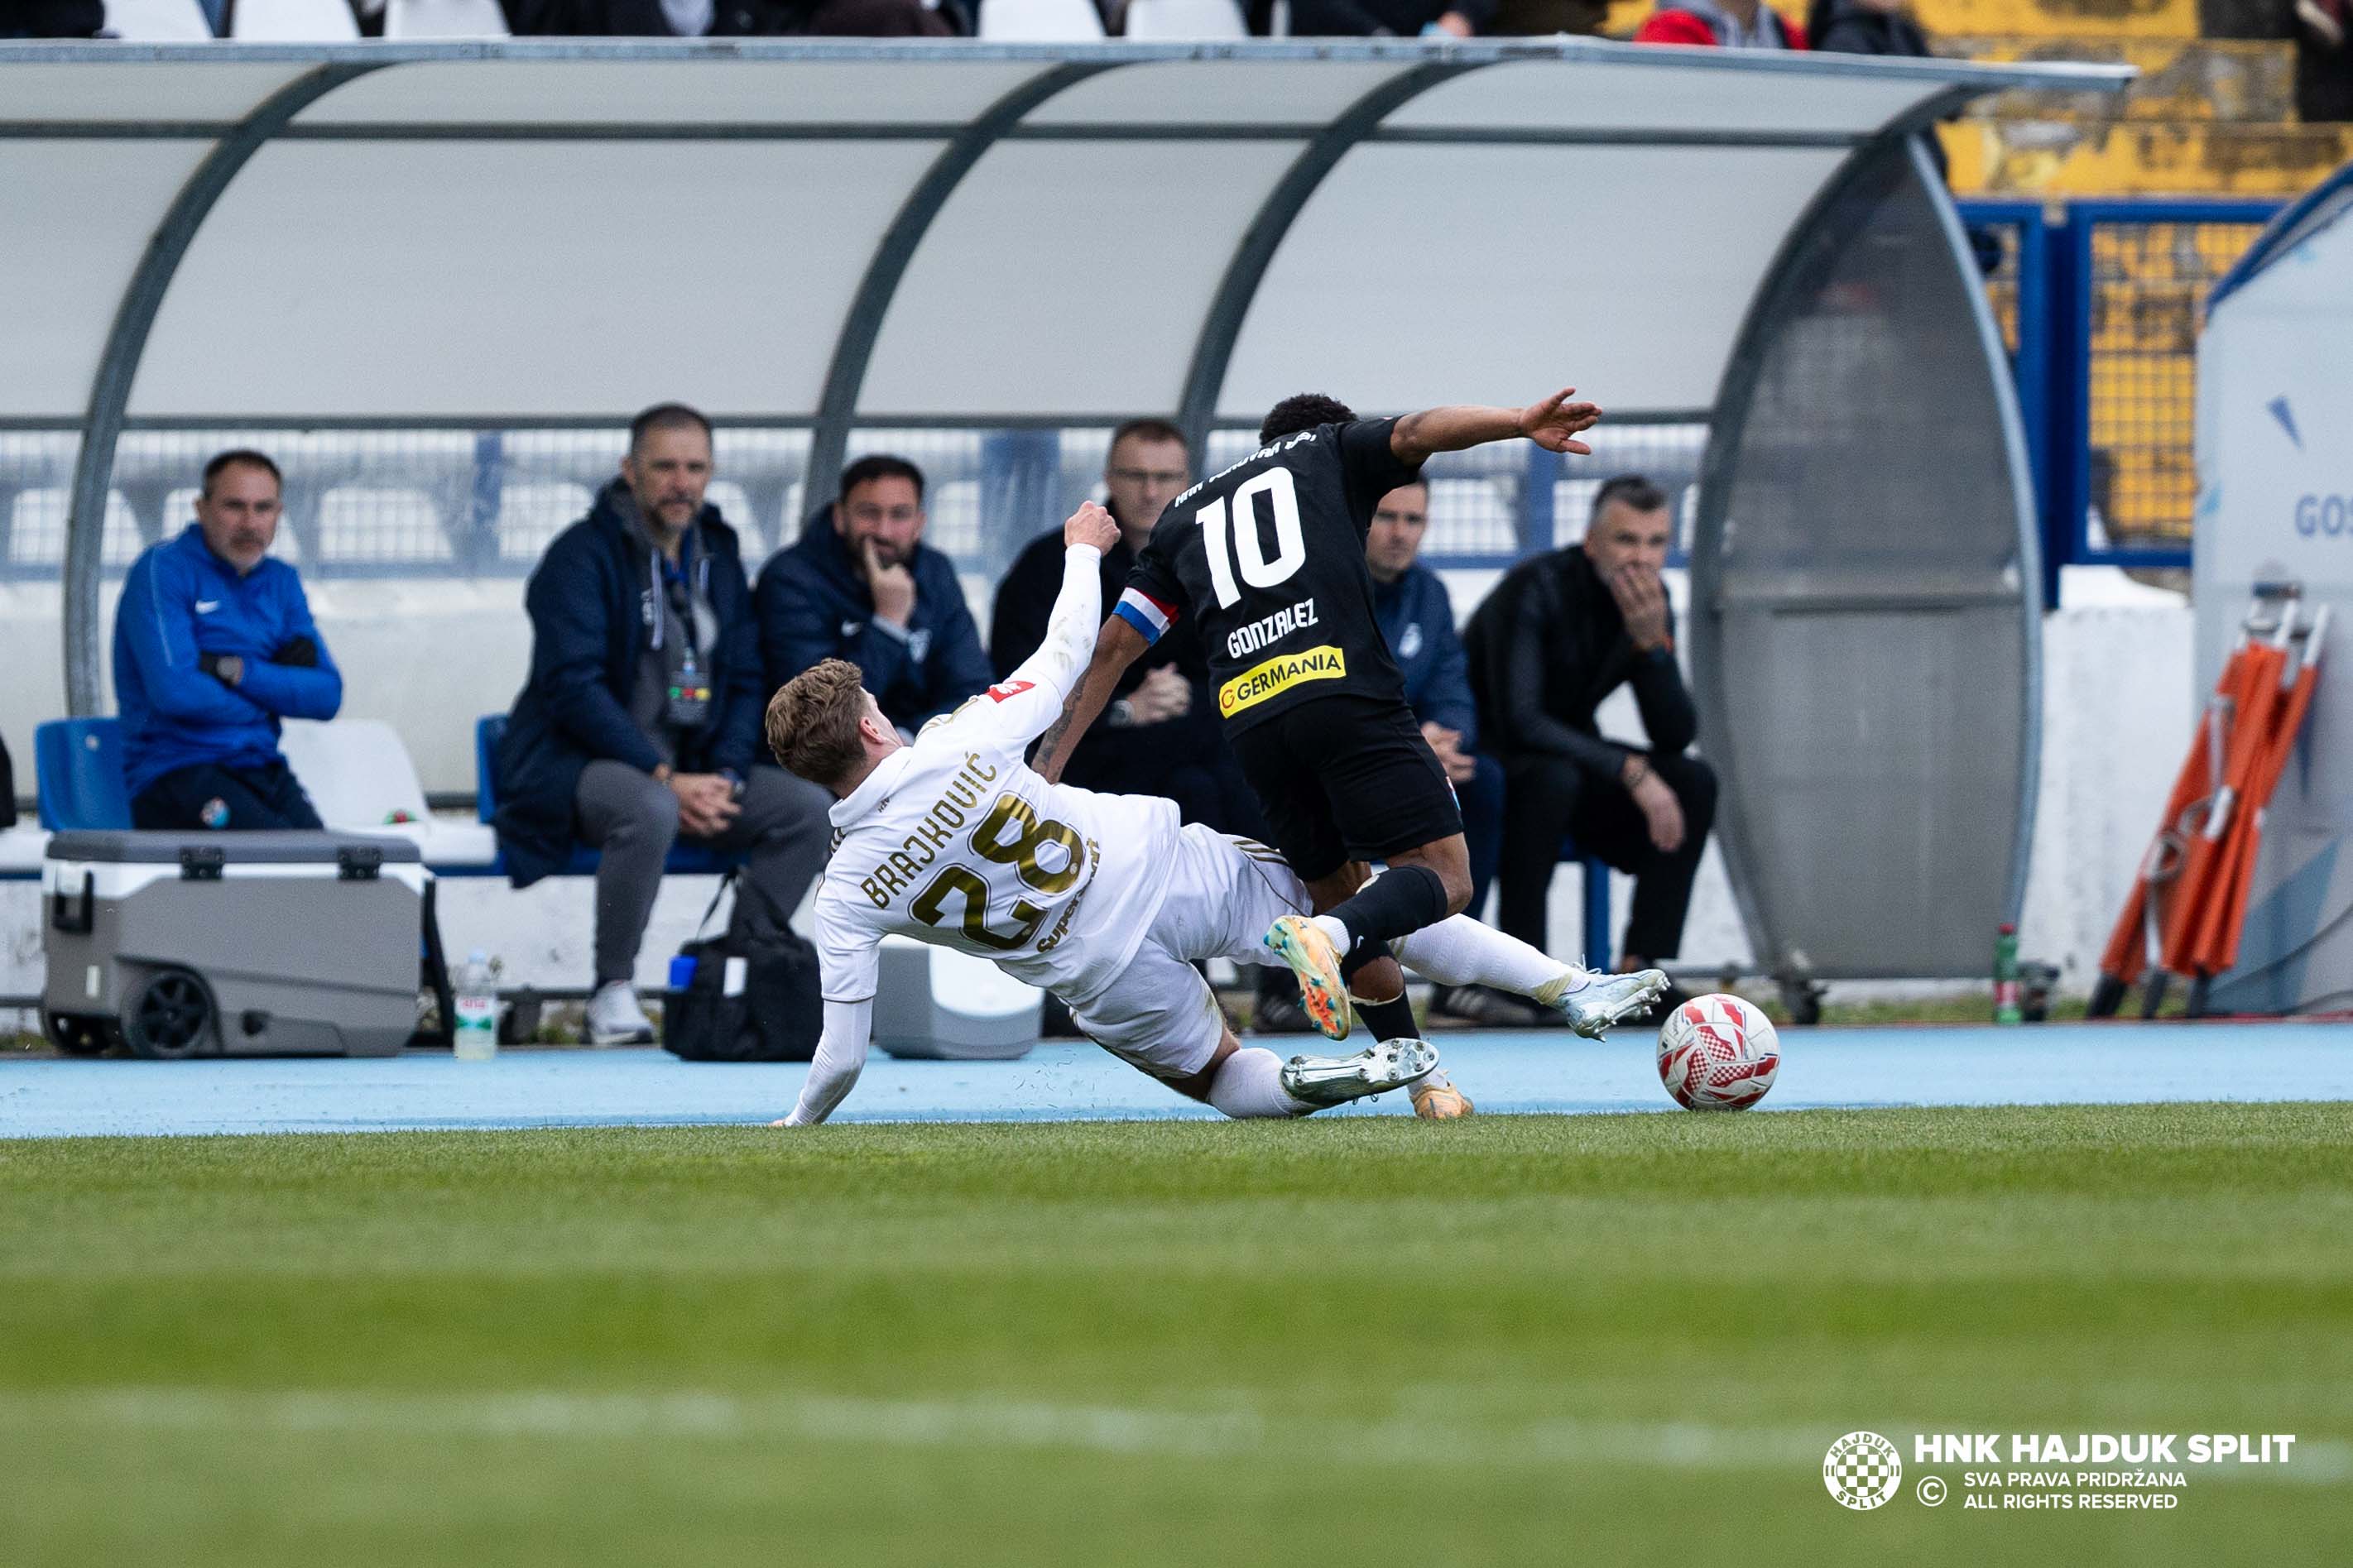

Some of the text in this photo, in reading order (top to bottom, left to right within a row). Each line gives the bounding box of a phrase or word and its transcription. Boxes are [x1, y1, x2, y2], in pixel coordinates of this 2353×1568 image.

[1196, 467, 1306, 610] 10
[1227, 597, 1319, 659] GONZALEZ
[1237, 654, 1342, 701] GERMANIA
[860, 751, 997, 909] BRAJKOVIĆ
[908, 789, 1086, 951] 28
